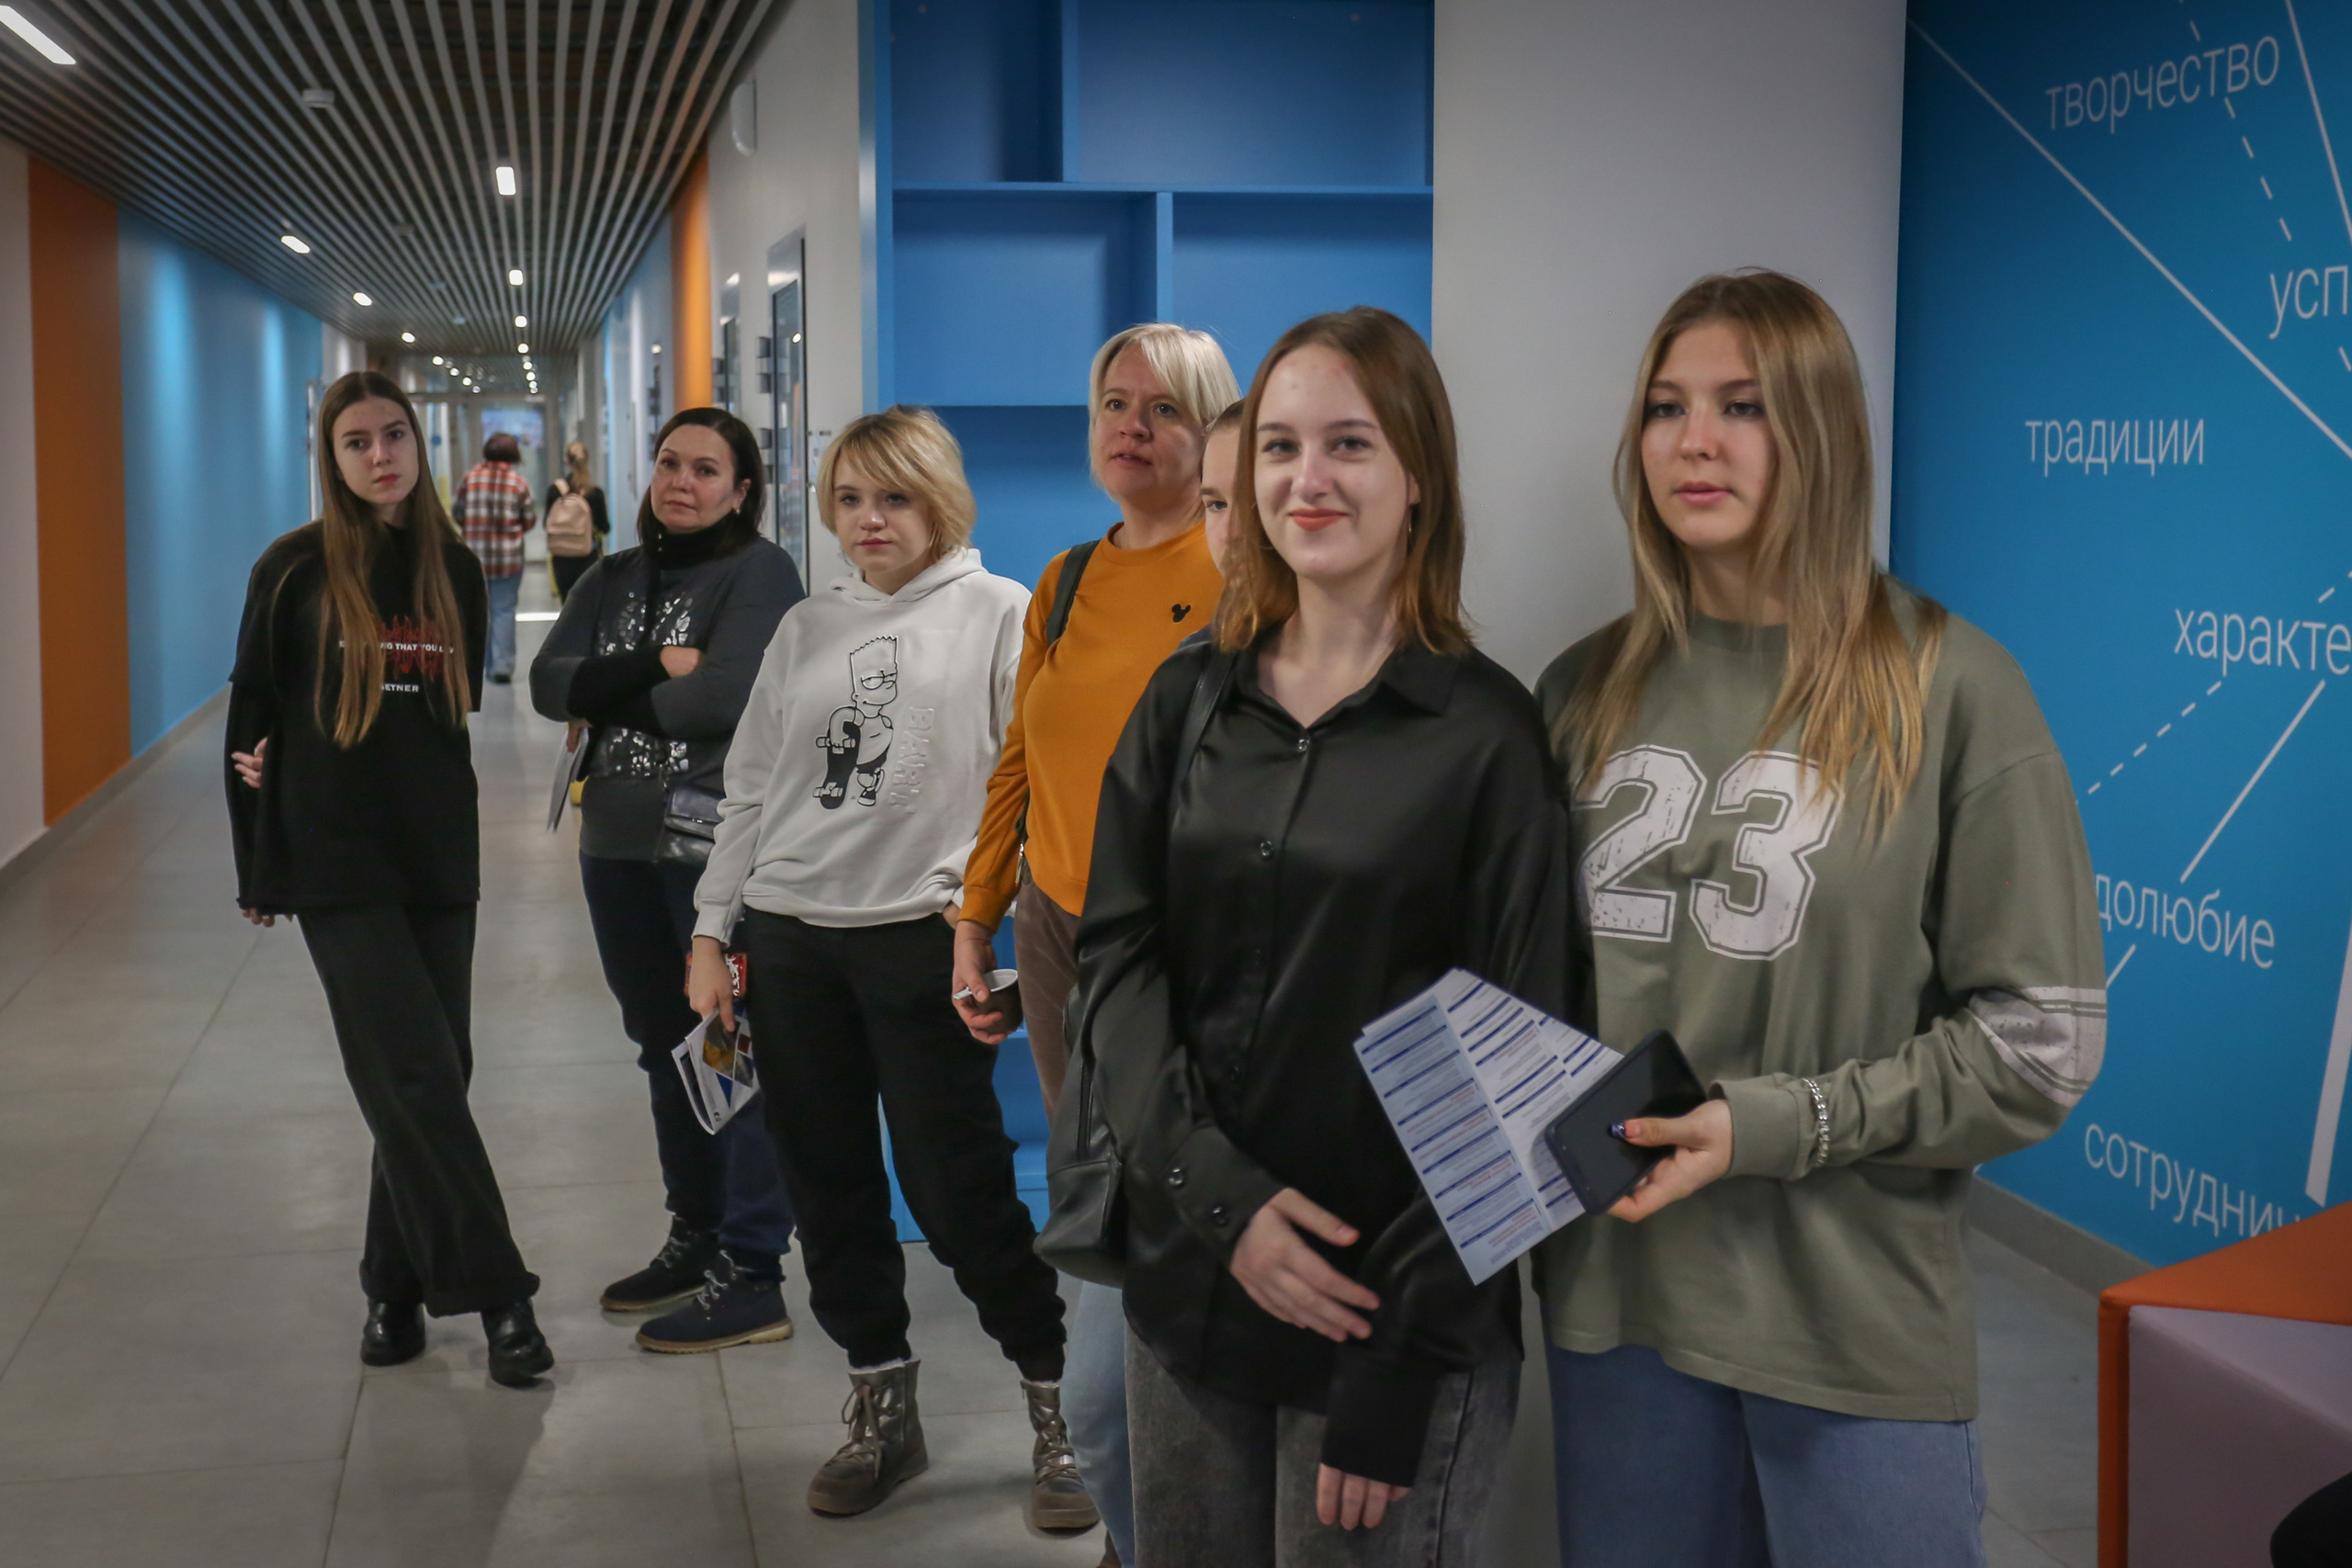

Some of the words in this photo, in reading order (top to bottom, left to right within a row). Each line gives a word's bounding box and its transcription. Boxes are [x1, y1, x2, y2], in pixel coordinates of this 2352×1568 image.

[2045, 35, 2279, 134] творчество
[2268, 264, 2349, 341] усп
[2024, 418, 2205, 479] традиции
[395, 642, 417, 651] THAT
[2174, 608, 2352, 678] характе
[1570, 743, 1845, 962] 23
[2095, 874, 2276, 970] долюбие
